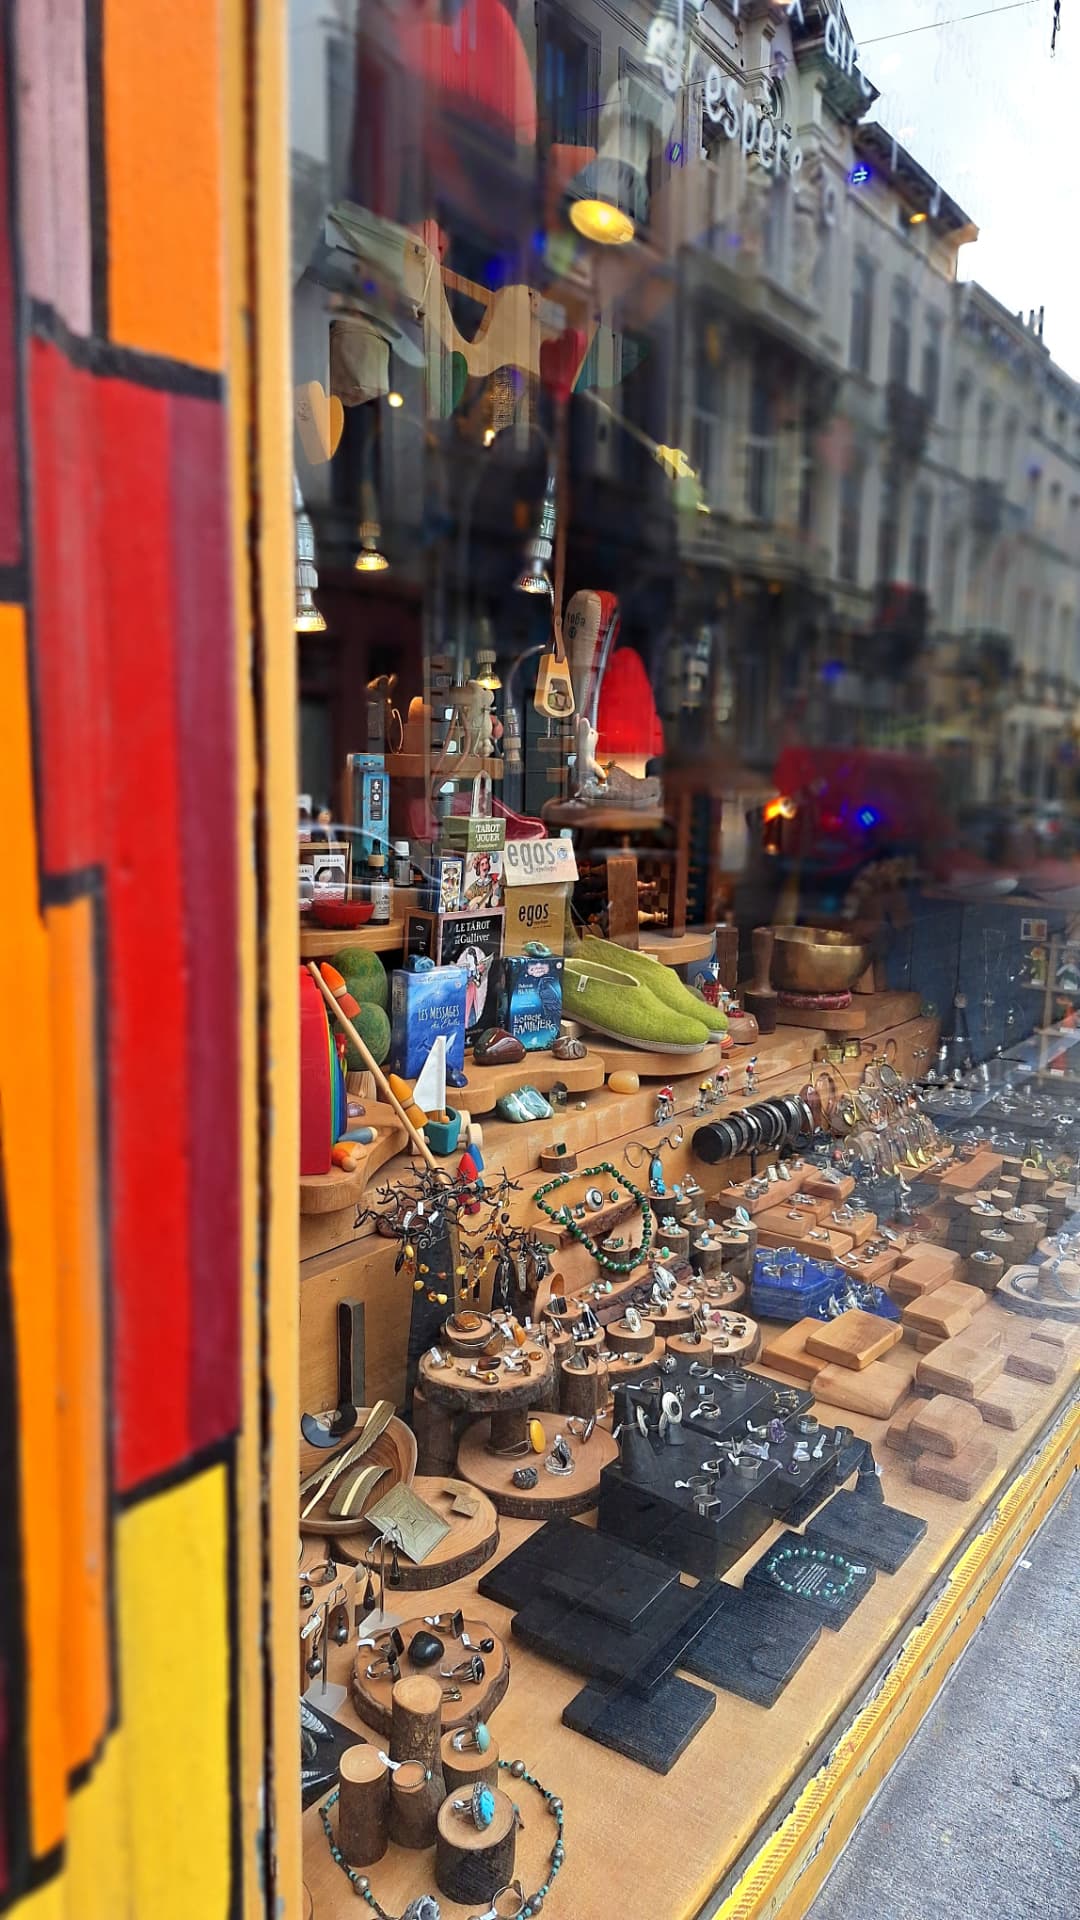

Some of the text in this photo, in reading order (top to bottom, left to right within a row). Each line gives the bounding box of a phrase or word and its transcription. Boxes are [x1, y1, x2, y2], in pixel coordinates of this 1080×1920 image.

[476, 823, 501, 833] TAROT
[507, 842, 556, 874] egos
[518, 903, 549, 927] egos
[466, 919, 491, 932] TAROT
[460, 933, 490, 944] Gulliver
[418, 1004, 460, 1021] LES MESSAGES
